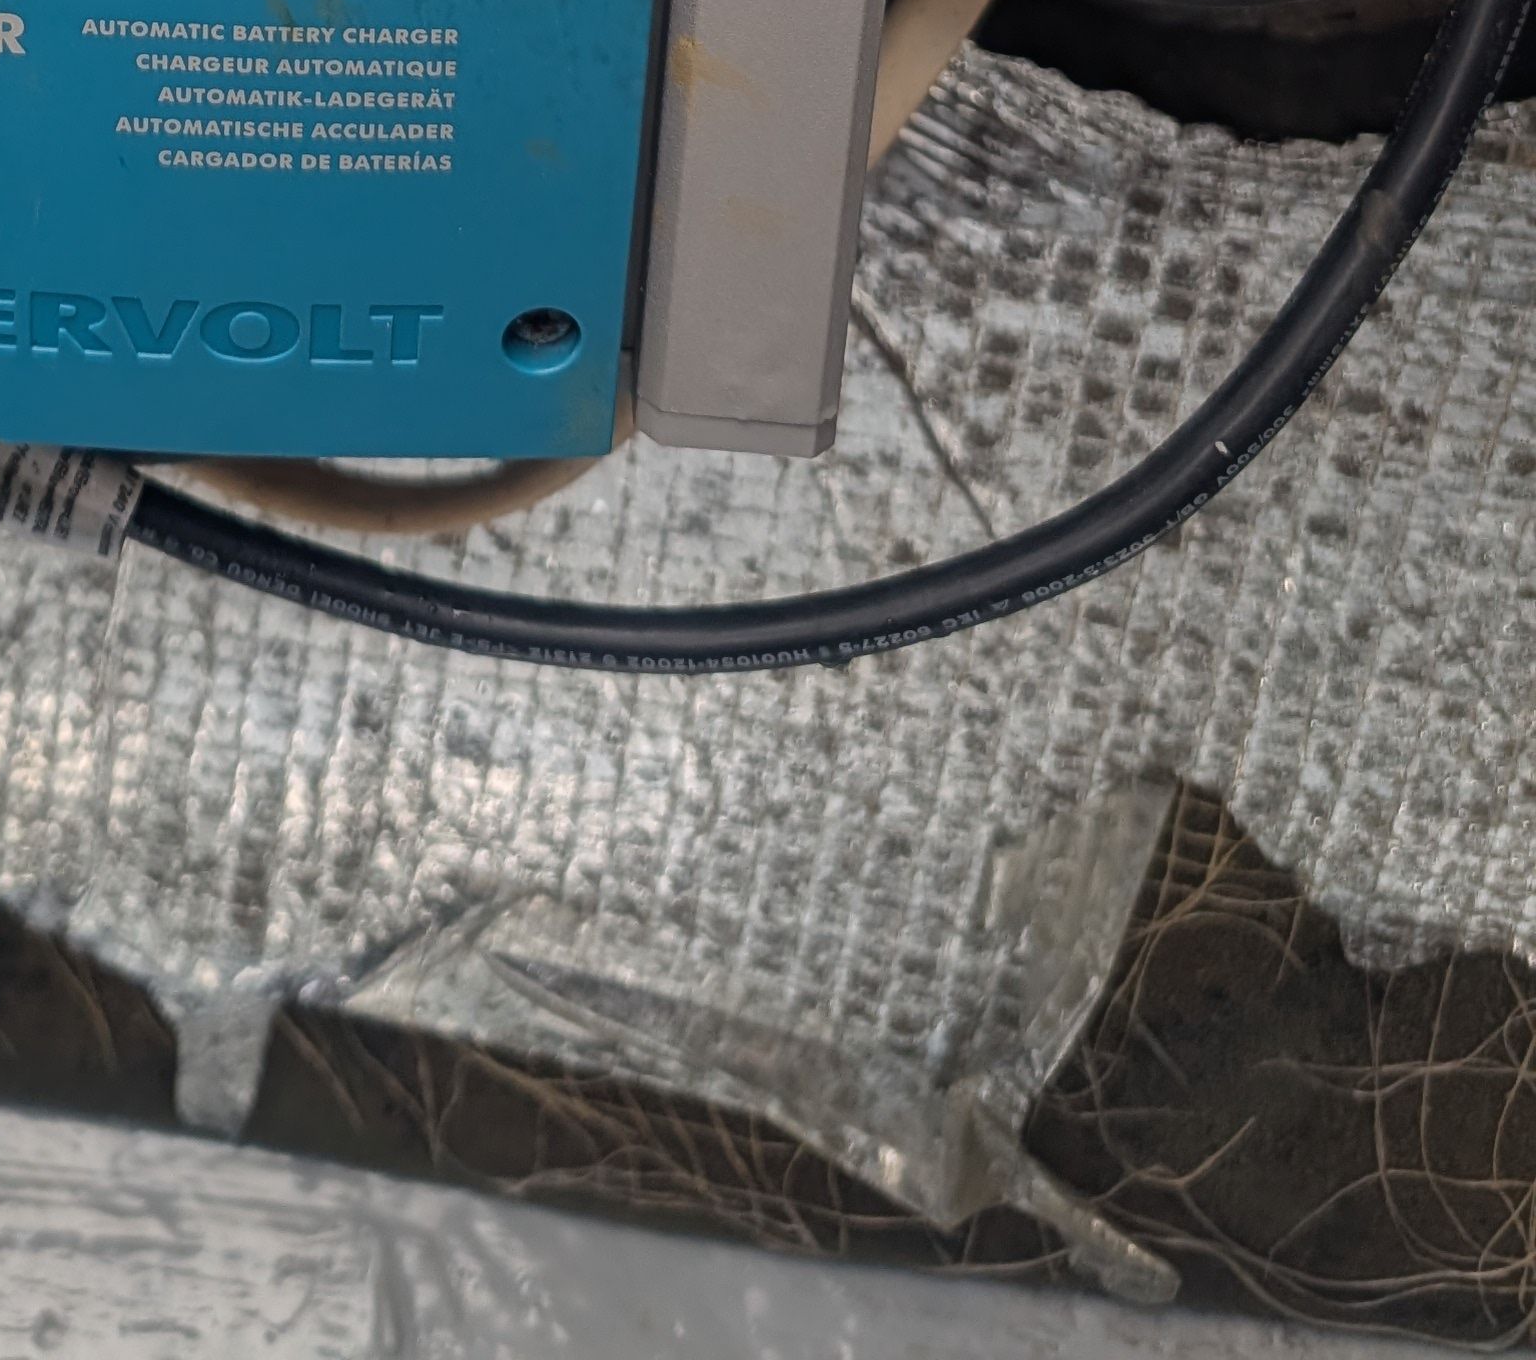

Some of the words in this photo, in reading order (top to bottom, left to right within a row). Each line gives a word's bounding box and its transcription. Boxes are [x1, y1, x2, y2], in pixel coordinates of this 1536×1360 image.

[82, 18, 225, 42] AUTOMATIC
[233, 24, 336, 45] BATTERY
[342, 26, 459, 46] CHARGER
[136, 53, 269, 75] CHARGEUR
[276, 58, 457, 78] AUTOMATIQUE
[158, 86, 455, 109] AUTOMATIK-LADEGERÄT
[115, 116, 304, 139] AUTOMATISCHE
[311, 121, 456, 141] ACCULADER
[158, 149, 293, 170] CARGADOR
[300, 152, 331, 171] DE
[338, 149, 452, 172] BATERÍAS
